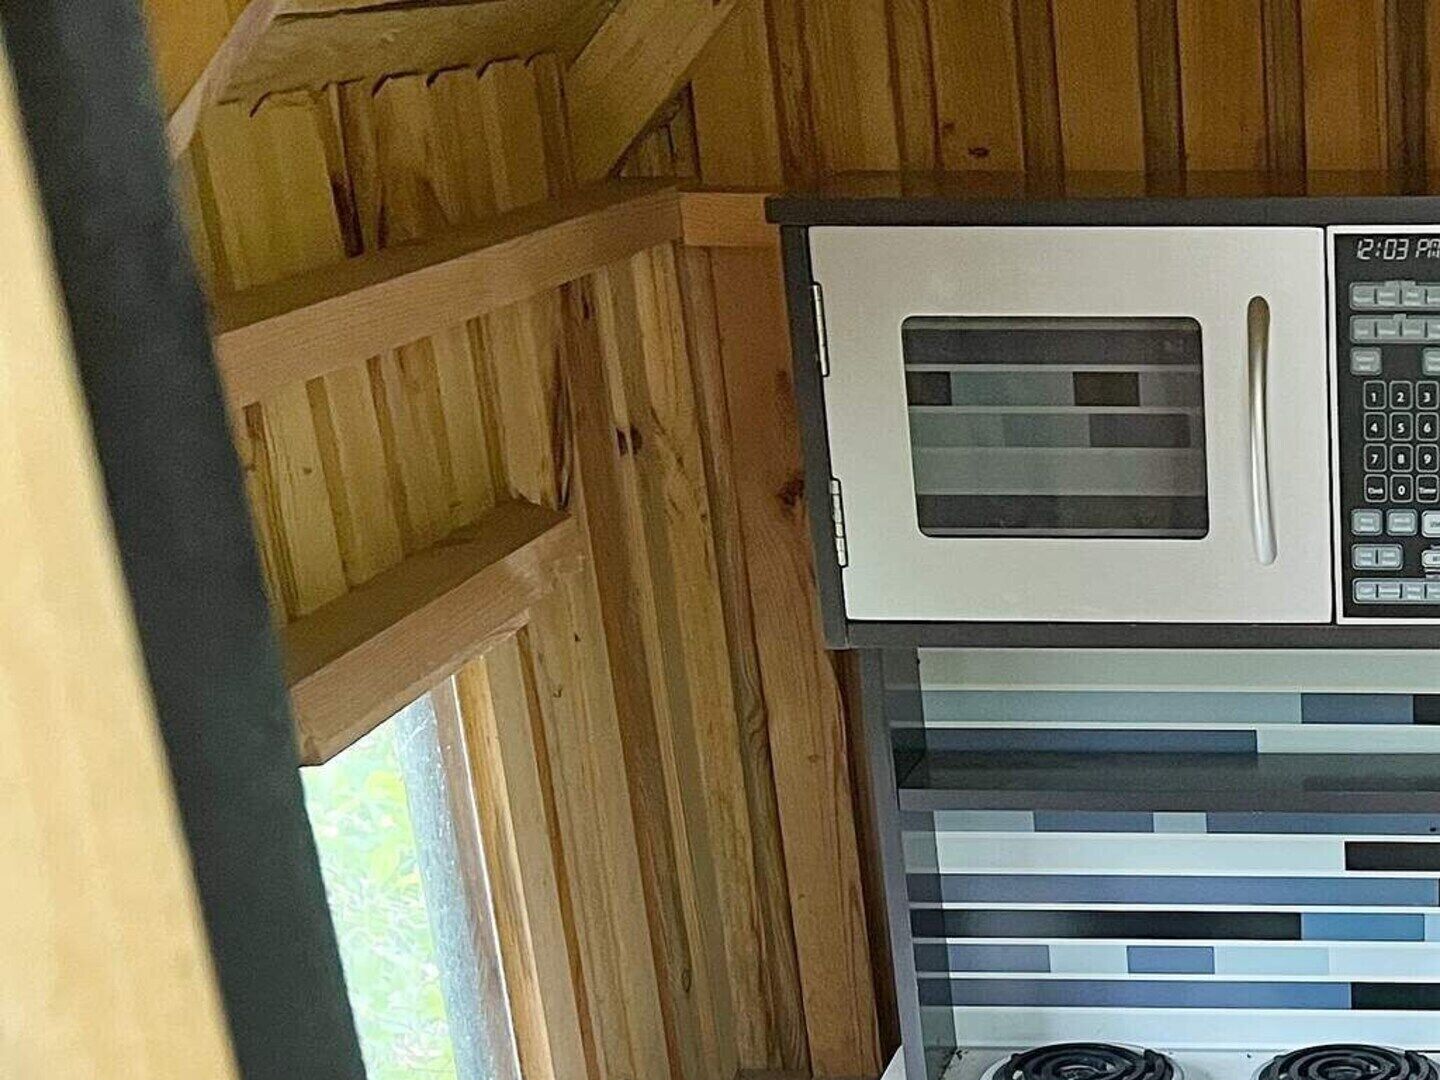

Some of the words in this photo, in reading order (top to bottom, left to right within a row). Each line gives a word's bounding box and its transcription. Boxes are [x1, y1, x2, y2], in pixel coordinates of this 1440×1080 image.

[1356, 238, 1410, 260] 12:03
[1371, 392, 1378, 402] 1
[1396, 392, 1405, 402] 2
[1424, 392, 1431, 402] 3
[1370, 423, 1378, 433] 4
[1397, 423, 1405, 433] 5
[1423, 423, 1431, 433] 6
[1371, 454, 1379, 464] 7
[1397, 453, 1405, 464] 8
[1424, 454, 1432, 464] 9
[1398, 485, 1406, 496] 0
